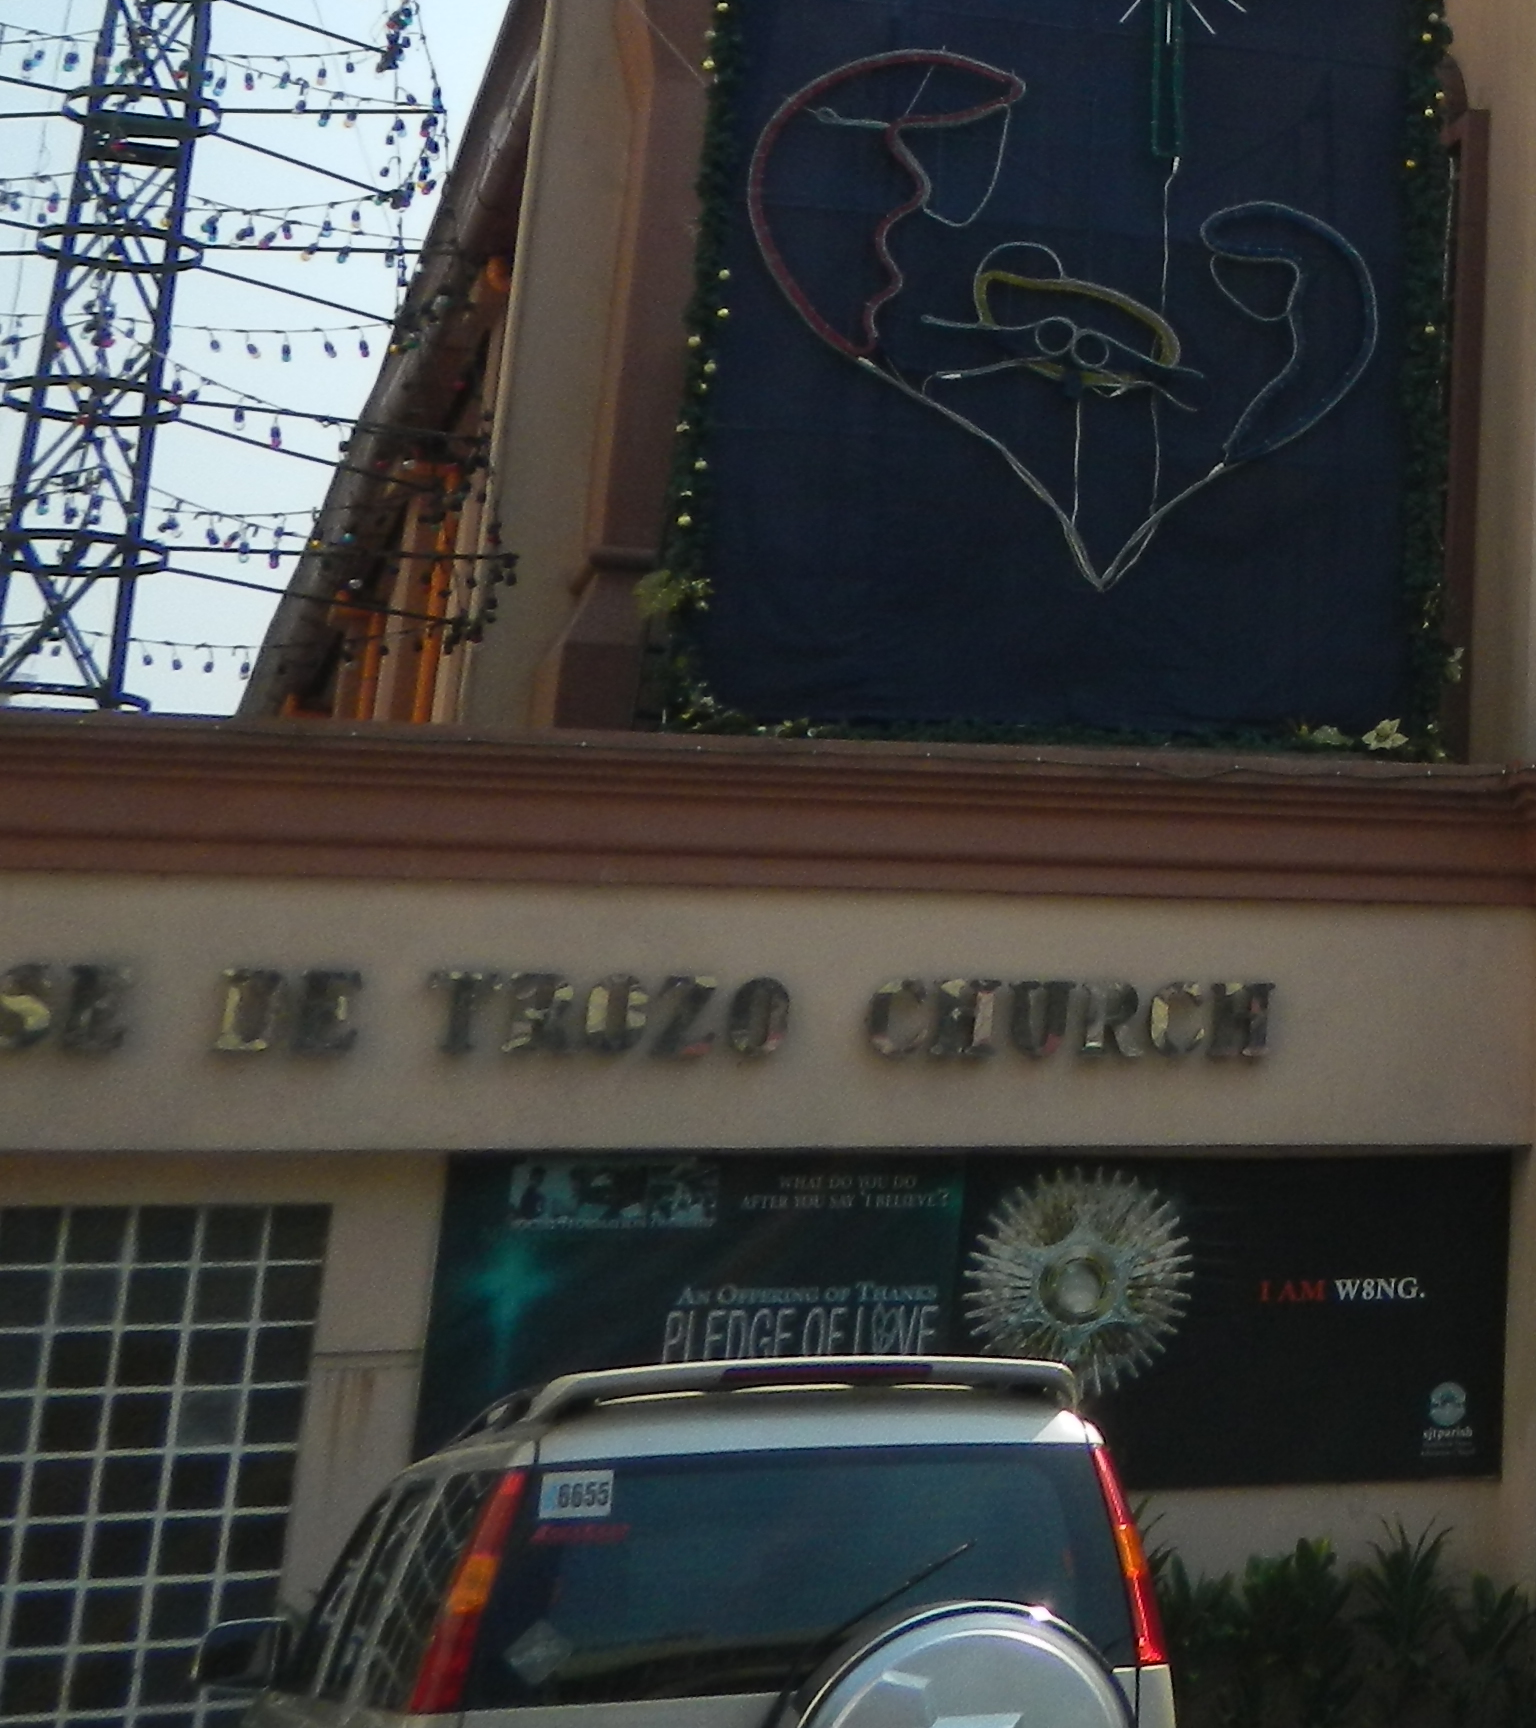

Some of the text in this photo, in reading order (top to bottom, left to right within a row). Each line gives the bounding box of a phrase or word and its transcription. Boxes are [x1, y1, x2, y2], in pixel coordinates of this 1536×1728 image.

[213, 968, 362, 1055] DE
[430, 969, 791, 1059] TROZO
[867, 977, 1277, 1060] CHURCH
[779, 1174, 919, 1190] WHAT DO YOU DO
[740, 1194, 789, 1210] AFTER
[794, 1194, 825, 1209] YOU
[829, 1194, 856, 1209] SAY
[1259, 1276, 1426, 1303] I AM W8NG.
[662, 1307, 797, 1364] PLEDGE
[802, 1306, 849, 1358] OF
[558, 1481, 609, 1508] 6655
